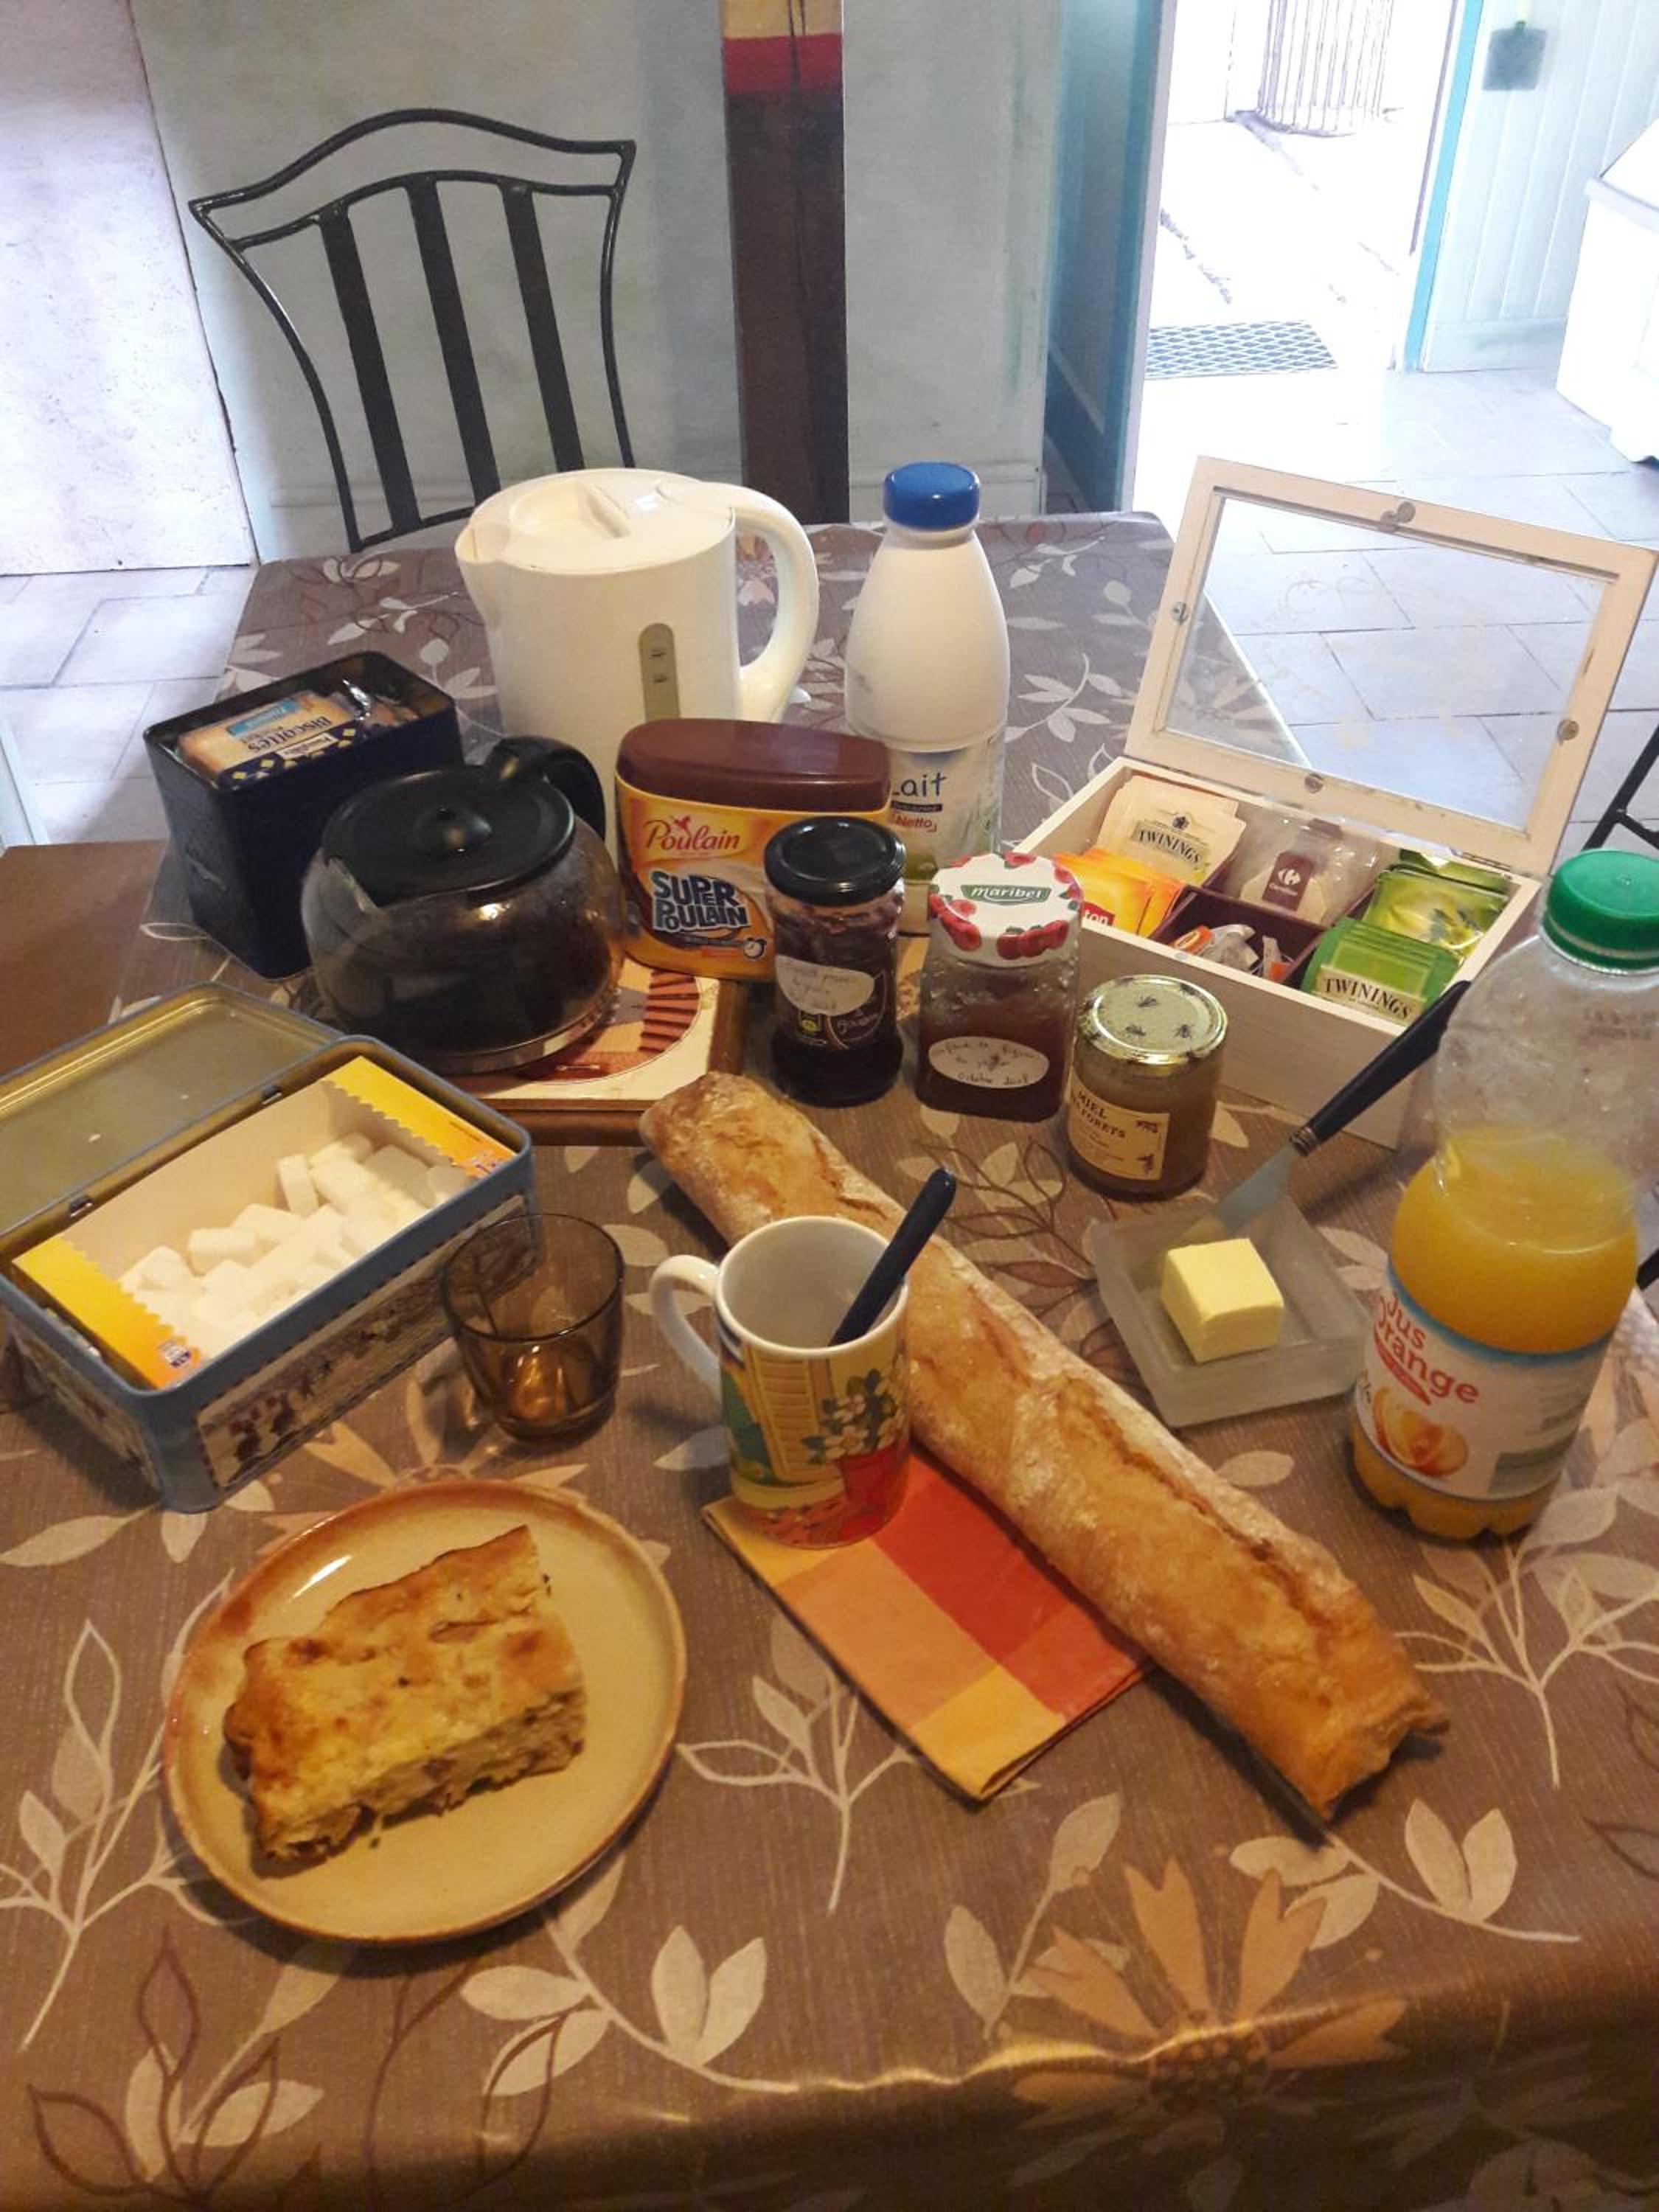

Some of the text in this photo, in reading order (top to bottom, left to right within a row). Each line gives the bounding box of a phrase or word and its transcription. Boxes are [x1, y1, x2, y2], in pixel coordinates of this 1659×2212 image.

[891, 773, 947, 796] ait
[643, 818, 740, 850] Poulain
[896, 815, 933, 828] Netto
[1139, 830, 1203, 863] TWININGS
[650, 870, 740, 907] SUPER
[971, 887, 1042, 900] maribel
[1085, 909, 1110, 925] ton
[1324, 978, 1412, 1018] TWININGS
